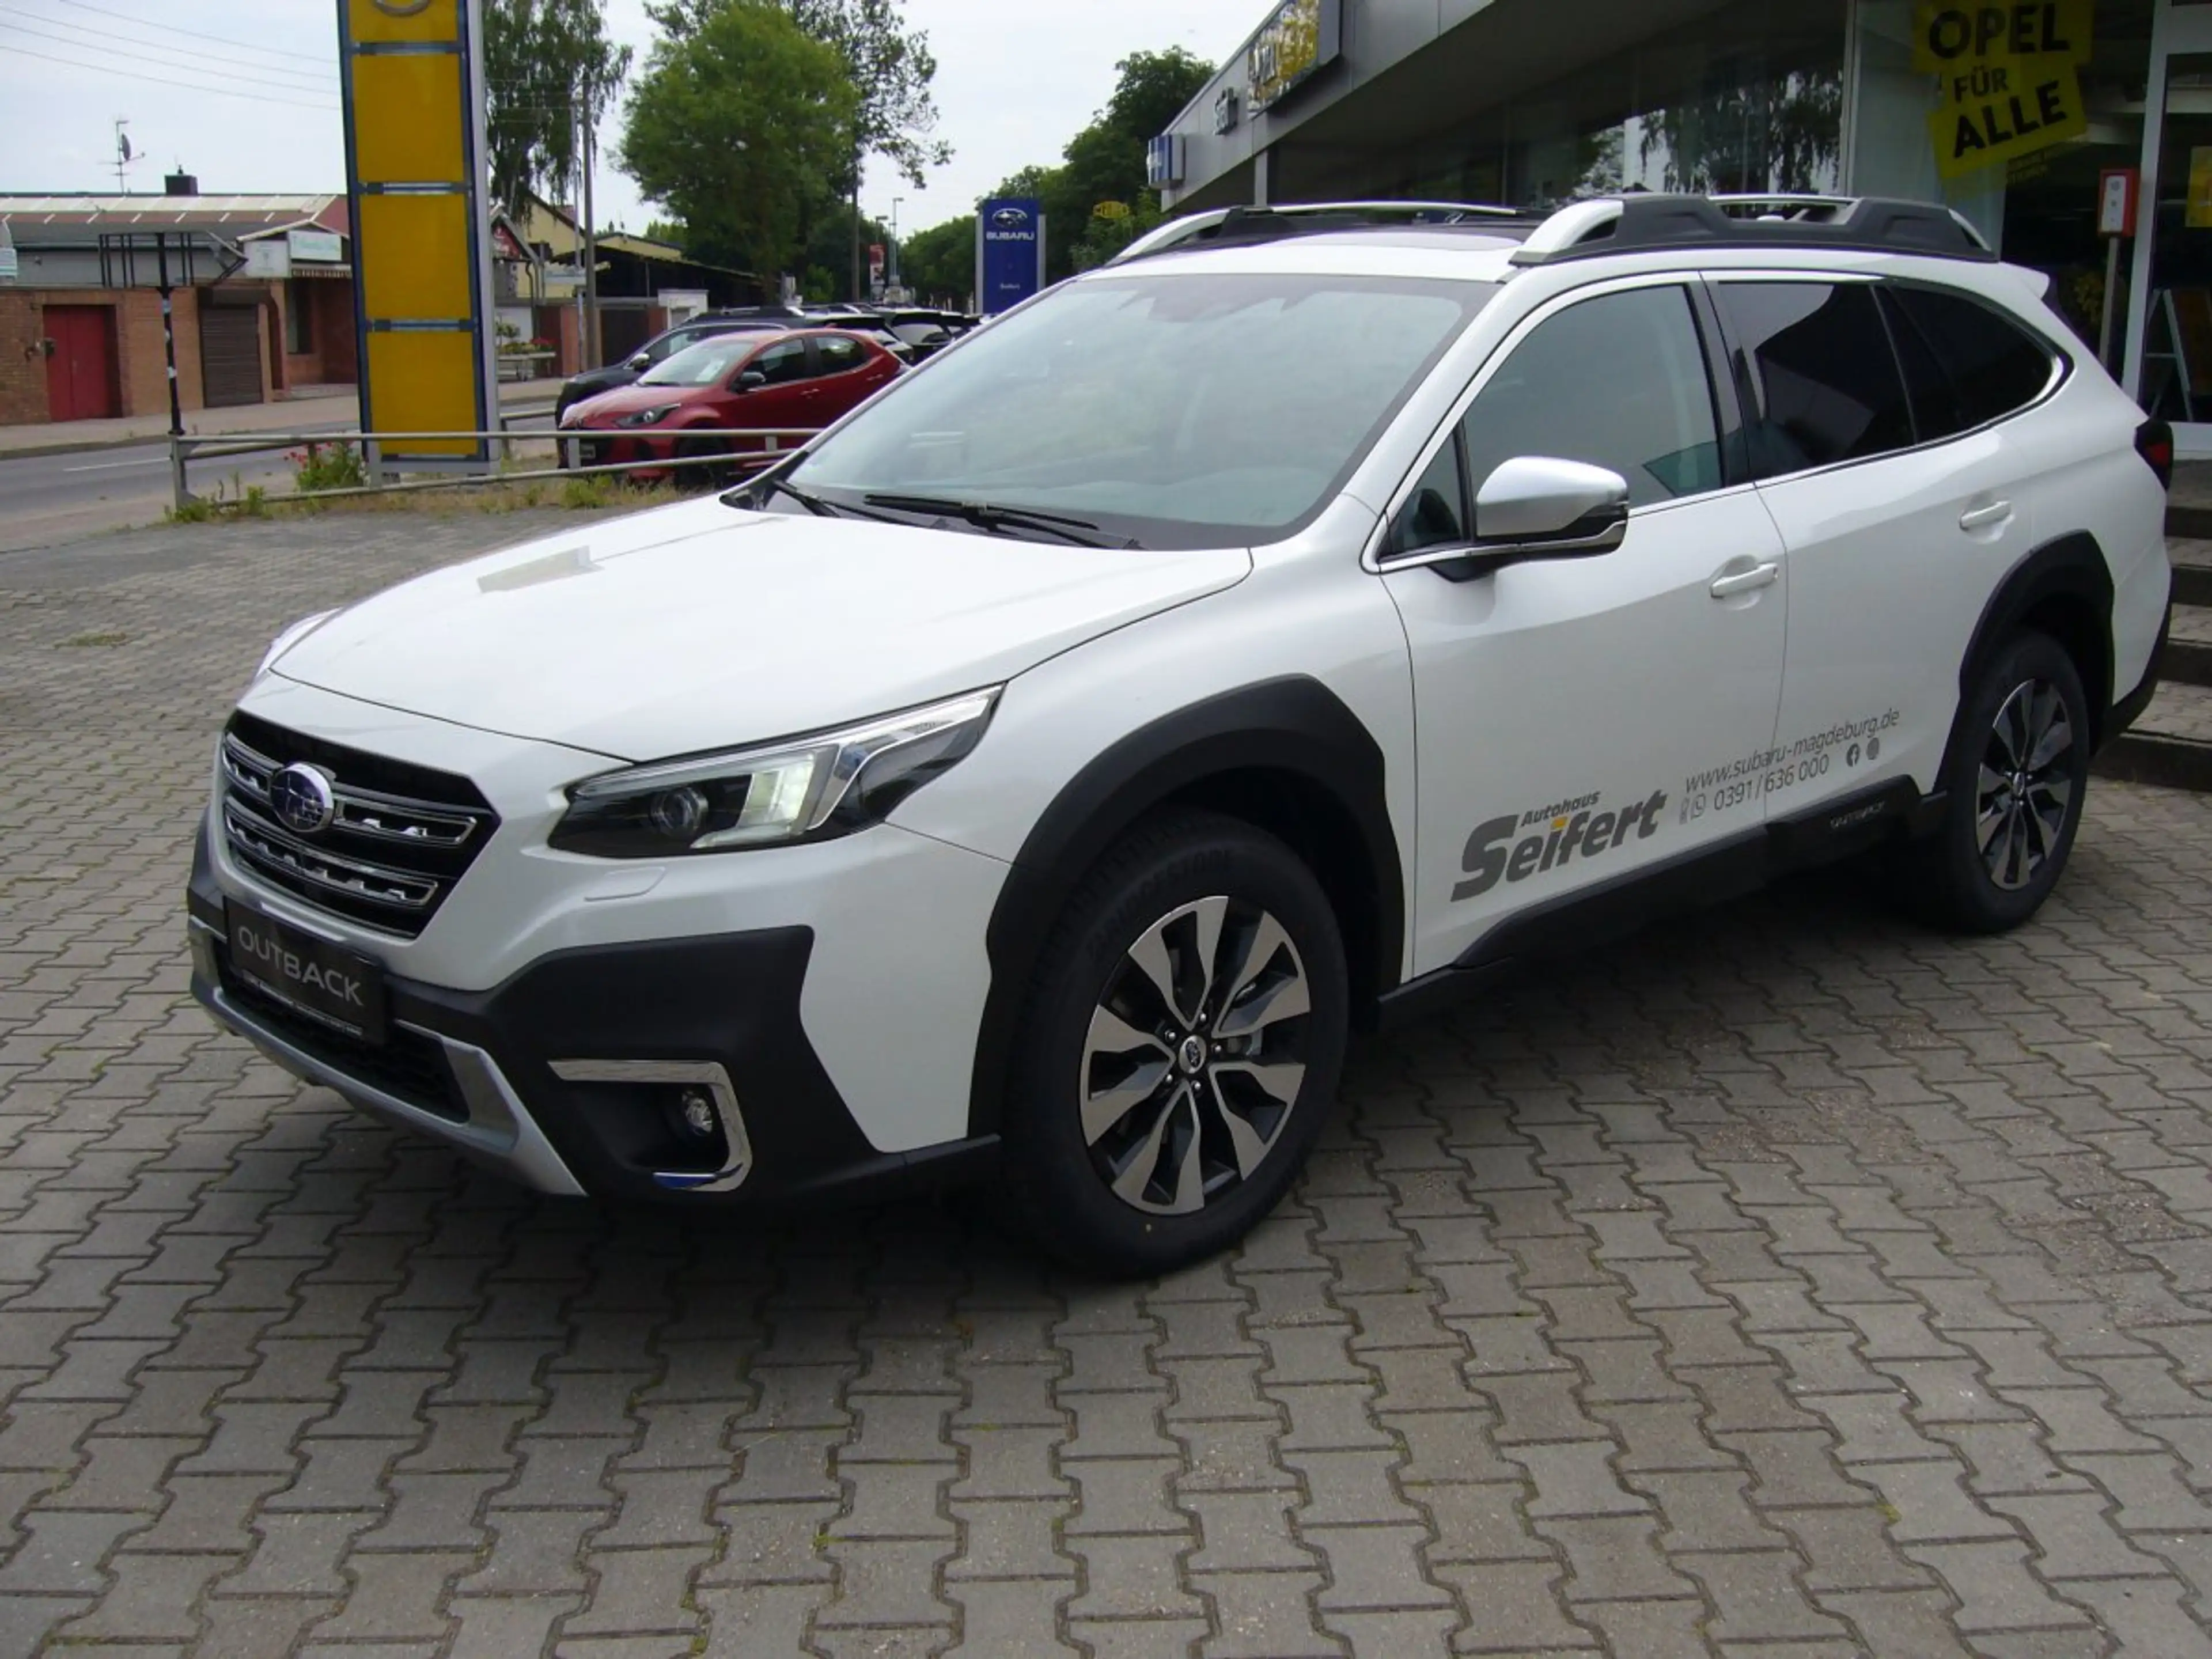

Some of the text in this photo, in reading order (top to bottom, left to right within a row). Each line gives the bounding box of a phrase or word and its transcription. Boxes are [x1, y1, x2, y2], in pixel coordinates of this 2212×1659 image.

[1929, 3, 2069, 59] OPEL
[1953, 65, 2009, 103] FÜR
[1953, 81, 2067, 158] ALLE
[1685, 707, 1900, 793] www.subaru-magdeburg.de
[1764, 764, 1795, 793] 636
[1798, 753, 1830, 781] 000
[1520, 791, 1601, 827] Autohaus
[1450, 790, 1668, 902] Seifert
[237, 925, 363, 1006] OUTBACK
